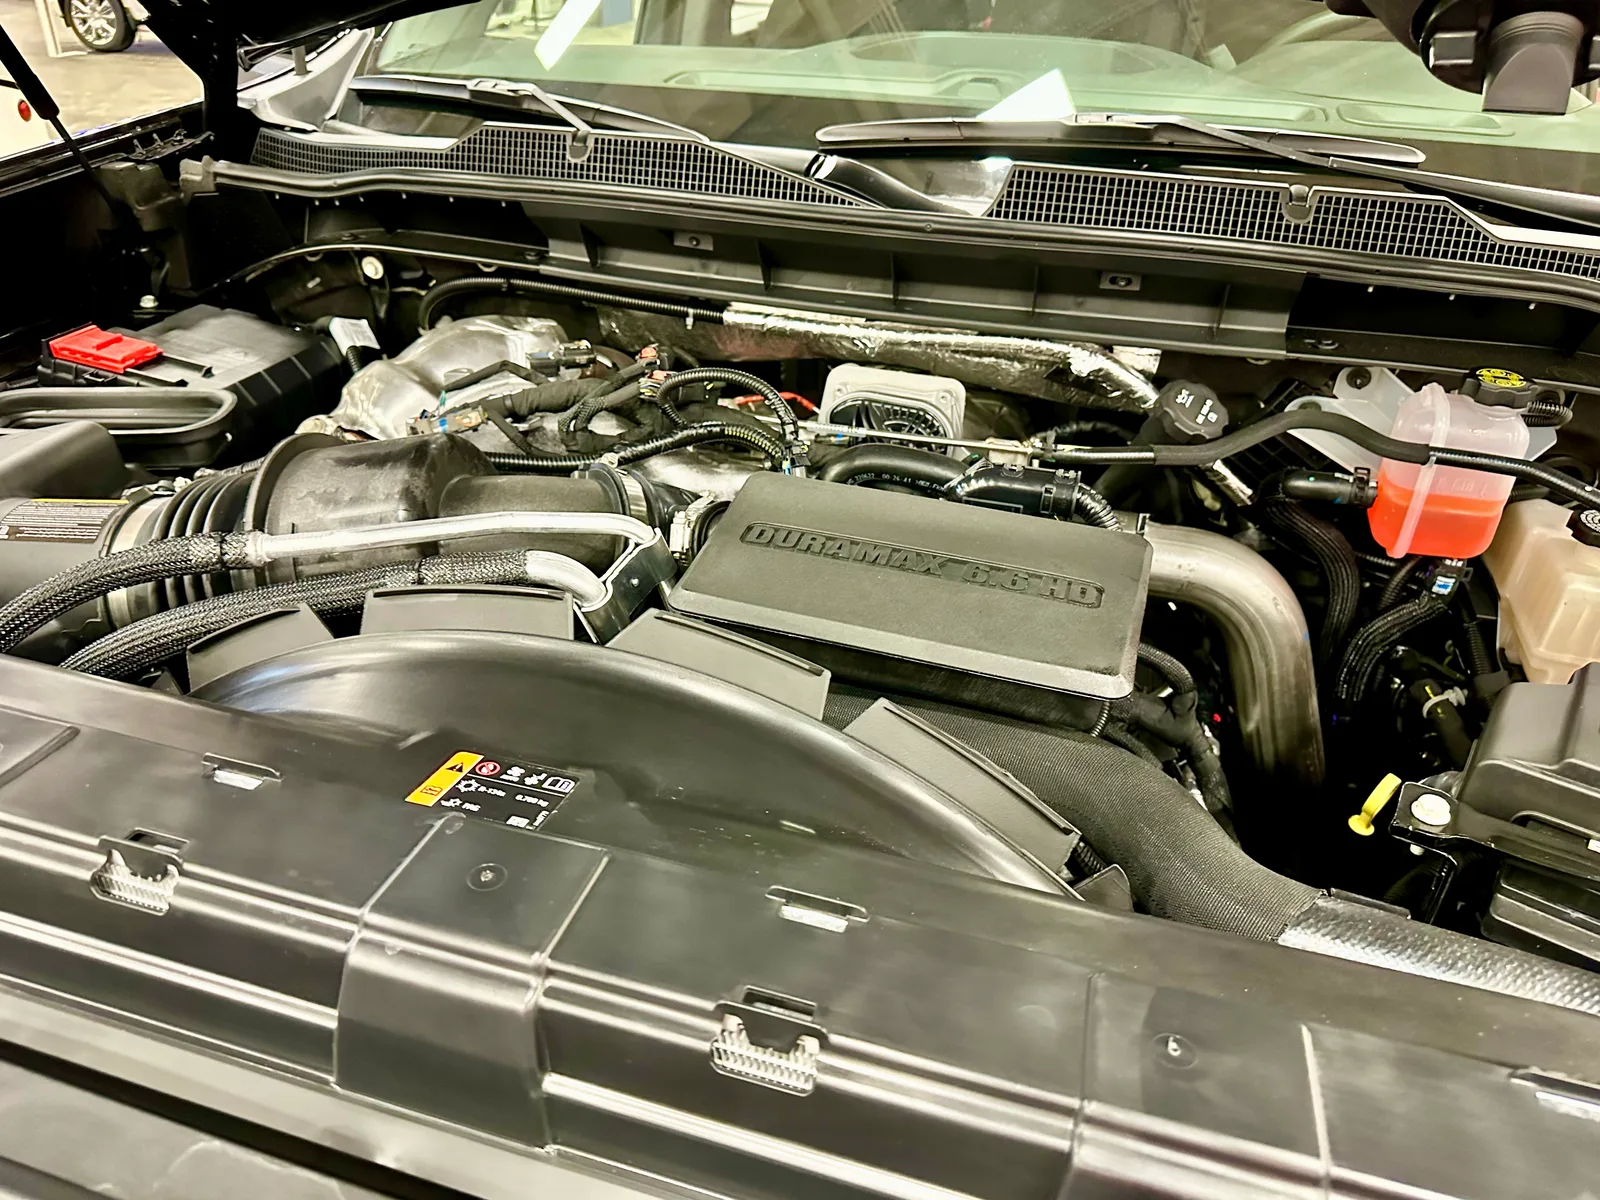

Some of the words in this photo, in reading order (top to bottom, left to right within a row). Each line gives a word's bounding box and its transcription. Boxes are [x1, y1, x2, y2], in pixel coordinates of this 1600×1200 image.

[750, 524, 949, 577] DURAMAX
[961, 561, 1030, 592] 6.6
[1039, 574, 1102, 606] HD
